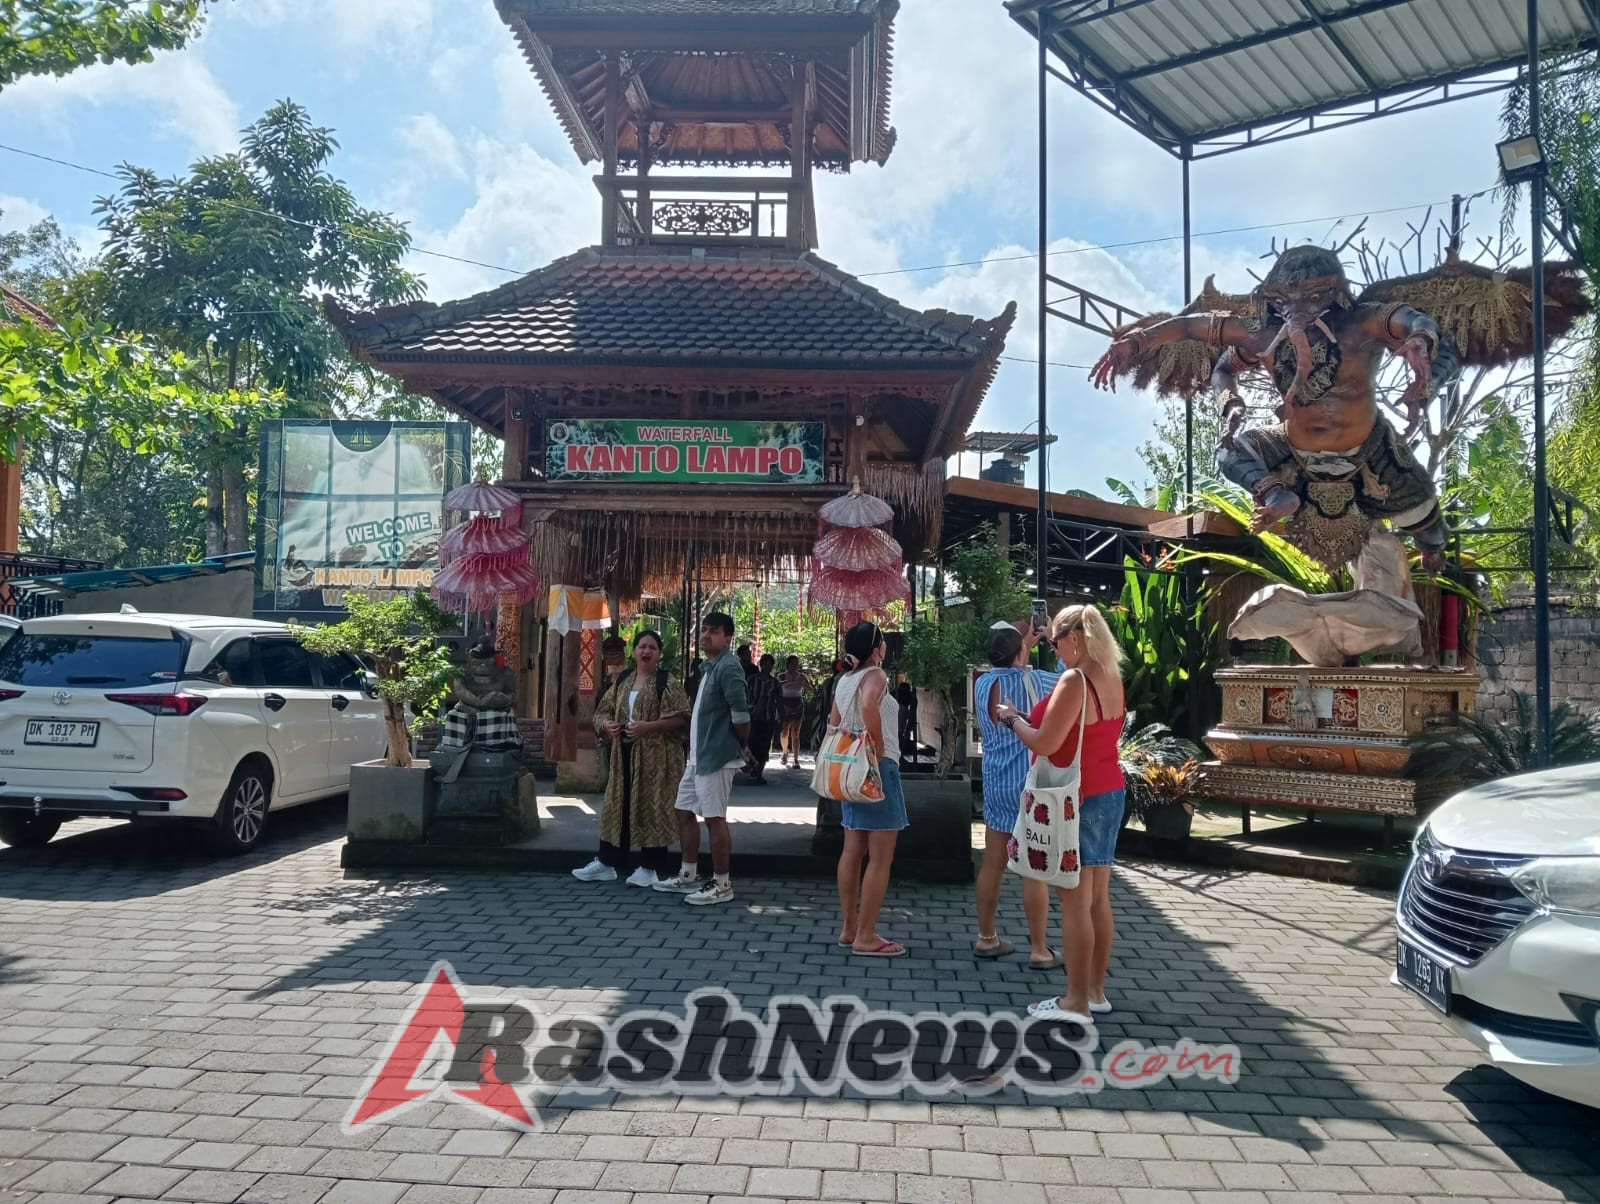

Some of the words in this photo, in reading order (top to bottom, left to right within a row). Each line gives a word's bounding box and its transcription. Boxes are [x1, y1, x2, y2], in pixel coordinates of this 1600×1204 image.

[637, 426, 733, 442] WATERFALL
[566, 445, 679, 473] KANTO
[687, 445, 803, 475] LAMPO
[346, 512, 431, 545] WELCOME
[380, 540, 404, 558] TO
[29, 723, 43, 735] DK
[48, 723, 76, 736] 1817
[80, 724, 95, 737] PM
[1026, 828, 1051, 845] BALI
[1398, 942, 1407, 968] DK
[1413, 951, 1432, 983] 1265
